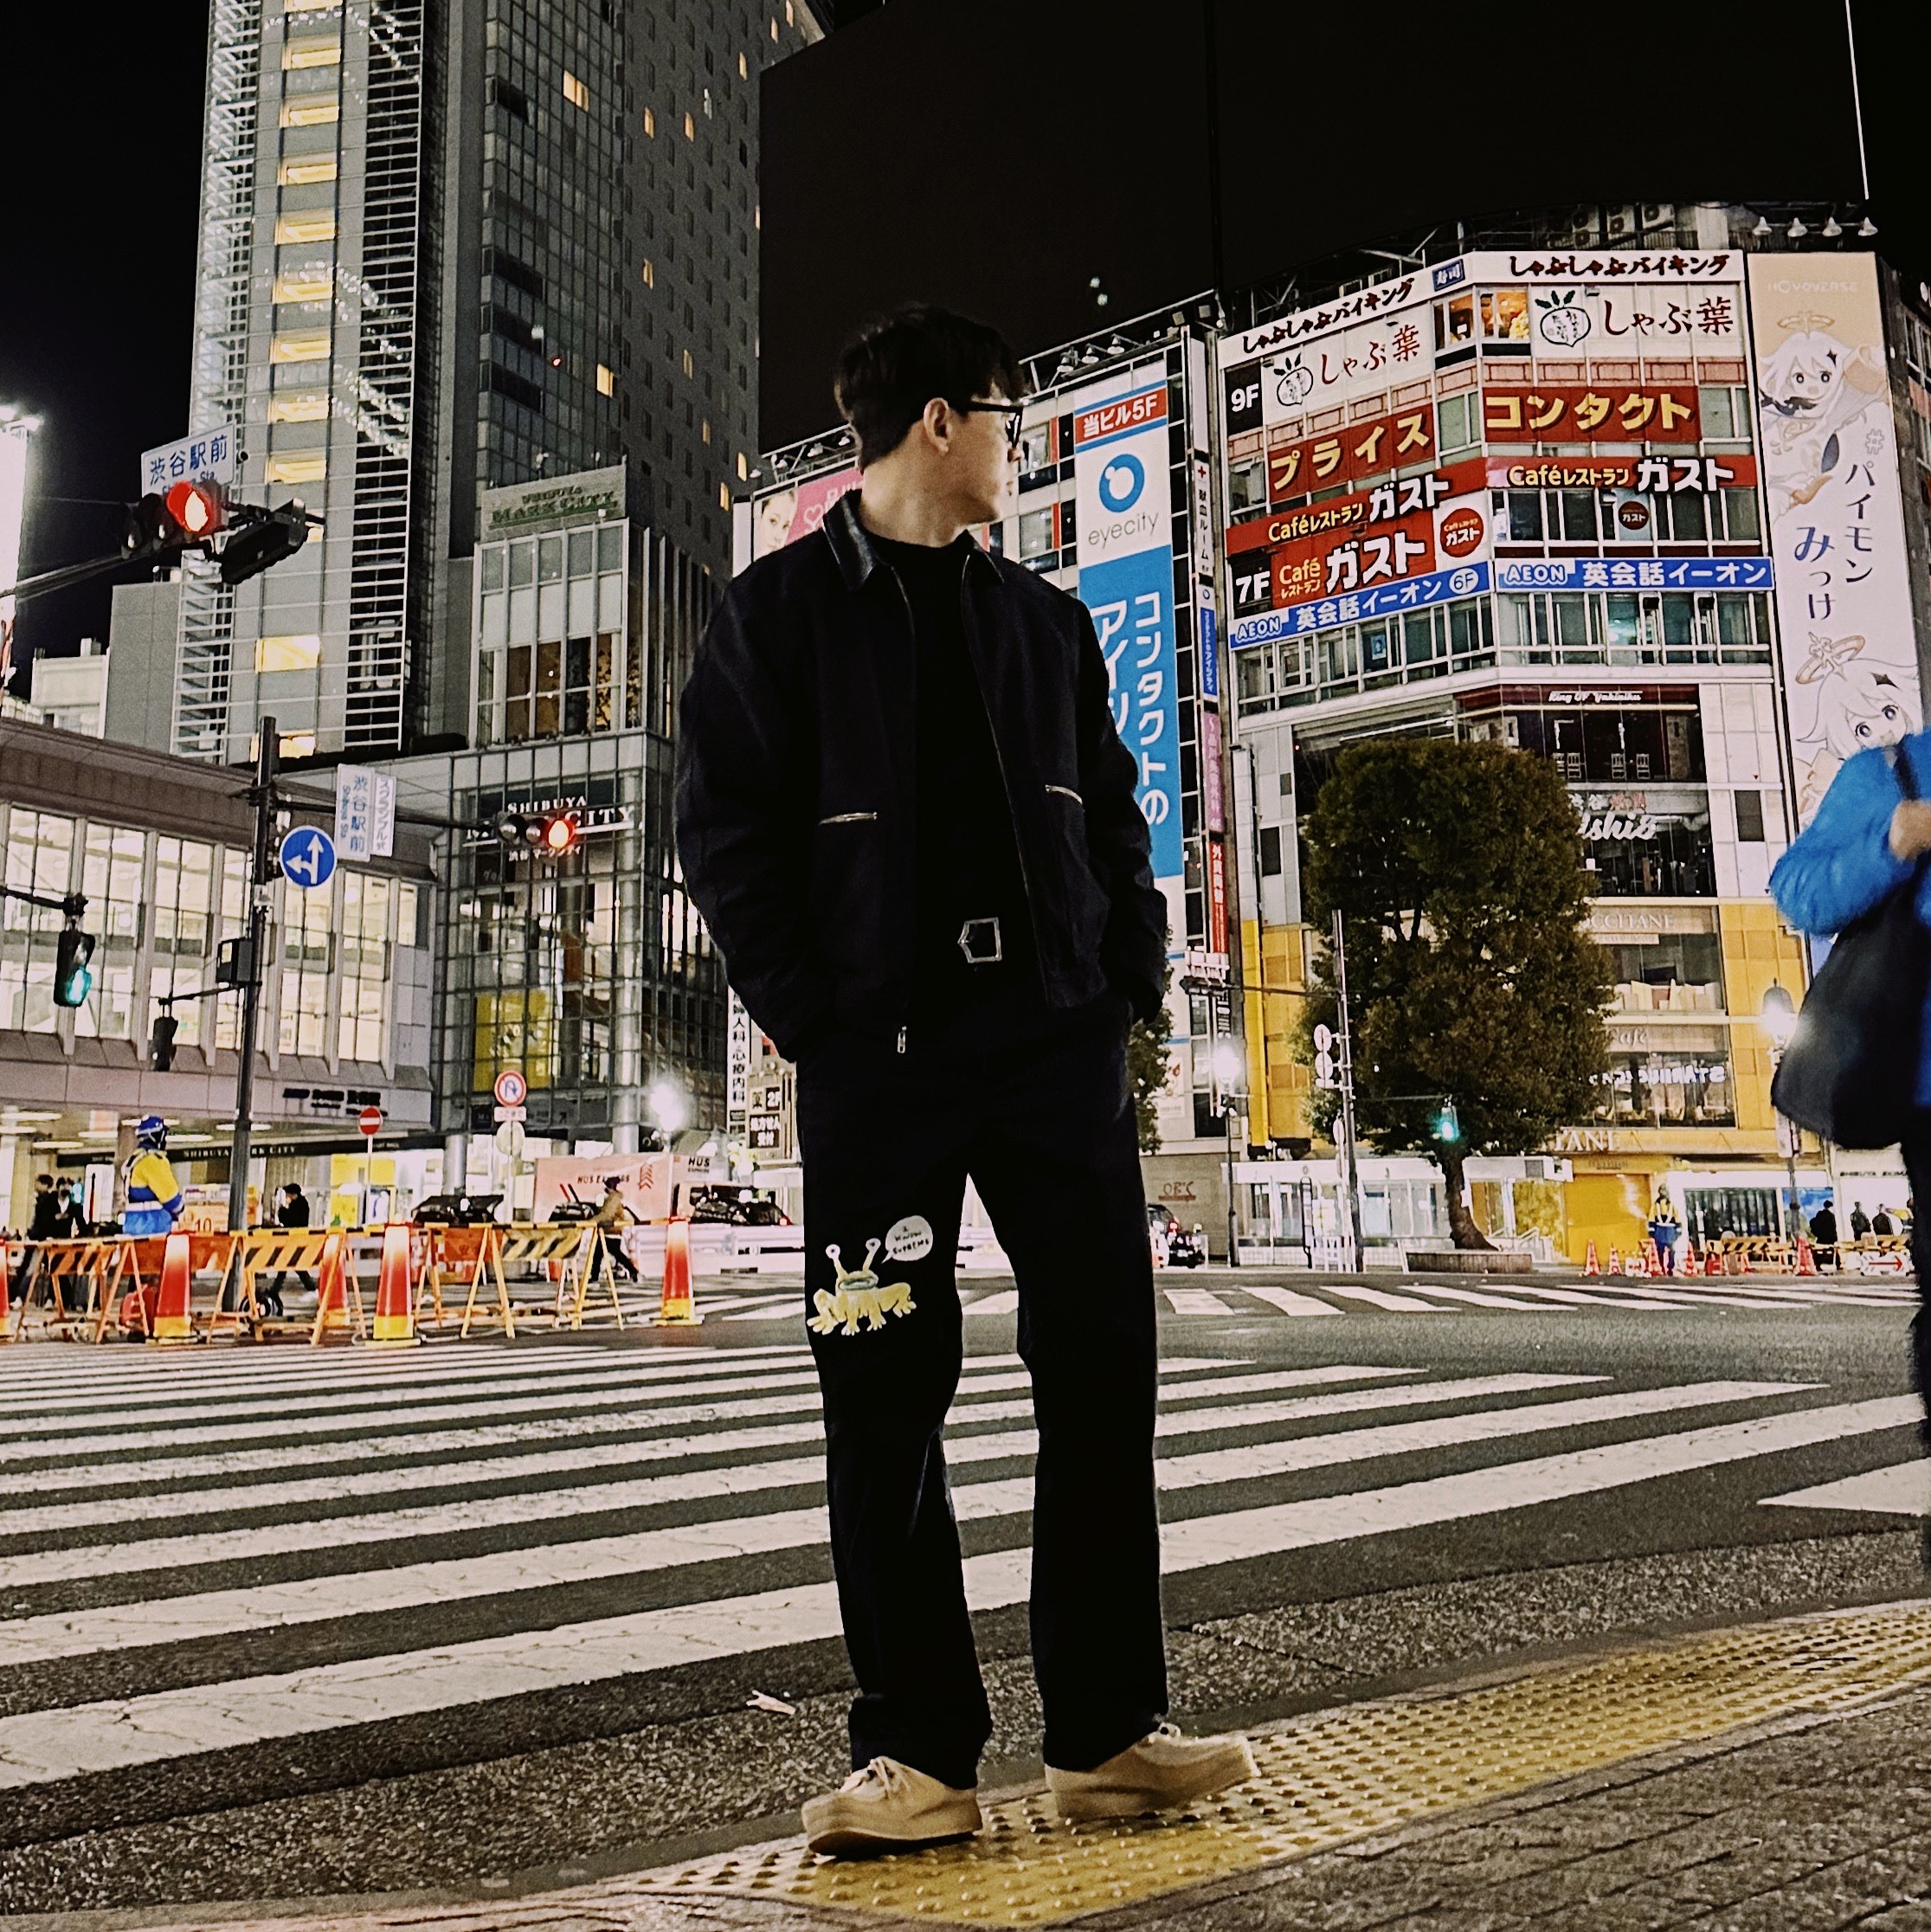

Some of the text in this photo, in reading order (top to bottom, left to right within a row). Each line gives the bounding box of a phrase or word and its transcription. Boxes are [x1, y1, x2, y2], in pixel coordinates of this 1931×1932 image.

[1509, 255, 1729, 276] しゃぶしゃぶバイキング
[1243, 278, 1415, 353] しゃぶしゃぶバイキング
[1604, 296, 1734, 336] しゃぶ葉
[1322, 324, 1420, 385] しゃぶ葉
[1084, 394, 1158, 438] 当ビル5F
[1231, 383, 1259, 412] 9F
[1485, 393, 1691, 431] コンタクト
[150, 435, 228, 486] 渋谷駅前
[1271, 414, 1430, 491] プライス
[1509, 456, 1735, 492] Caféレストラン ガスト
[1267, 473, 1449, 543] Caféレストラン ガスト
[1621, 512, 1646, 524] ガスト
[1088, 512, 1159, 548] eyecity
[1445, 526, 1481, 547] ガスト
[1279, 557, 1321, 586] Café
[1326, 531, 1426, 594] ガスト
[1507, 562, 1767, 589] AEON 英会話イーオン
[1793, 526, 1837, 621] みっけ
[1235, 570, 1271, 604] 7F
[1281, 578, 1321, 598] レストラン
[1237, 570, 1475, 643] AEON 英会話イーオン 6F
[1135, 591, 1170, 825] コンタクトの
[507, 795, 588, 815] SHIBUYA
[564, 805, 635, 828] CITY
